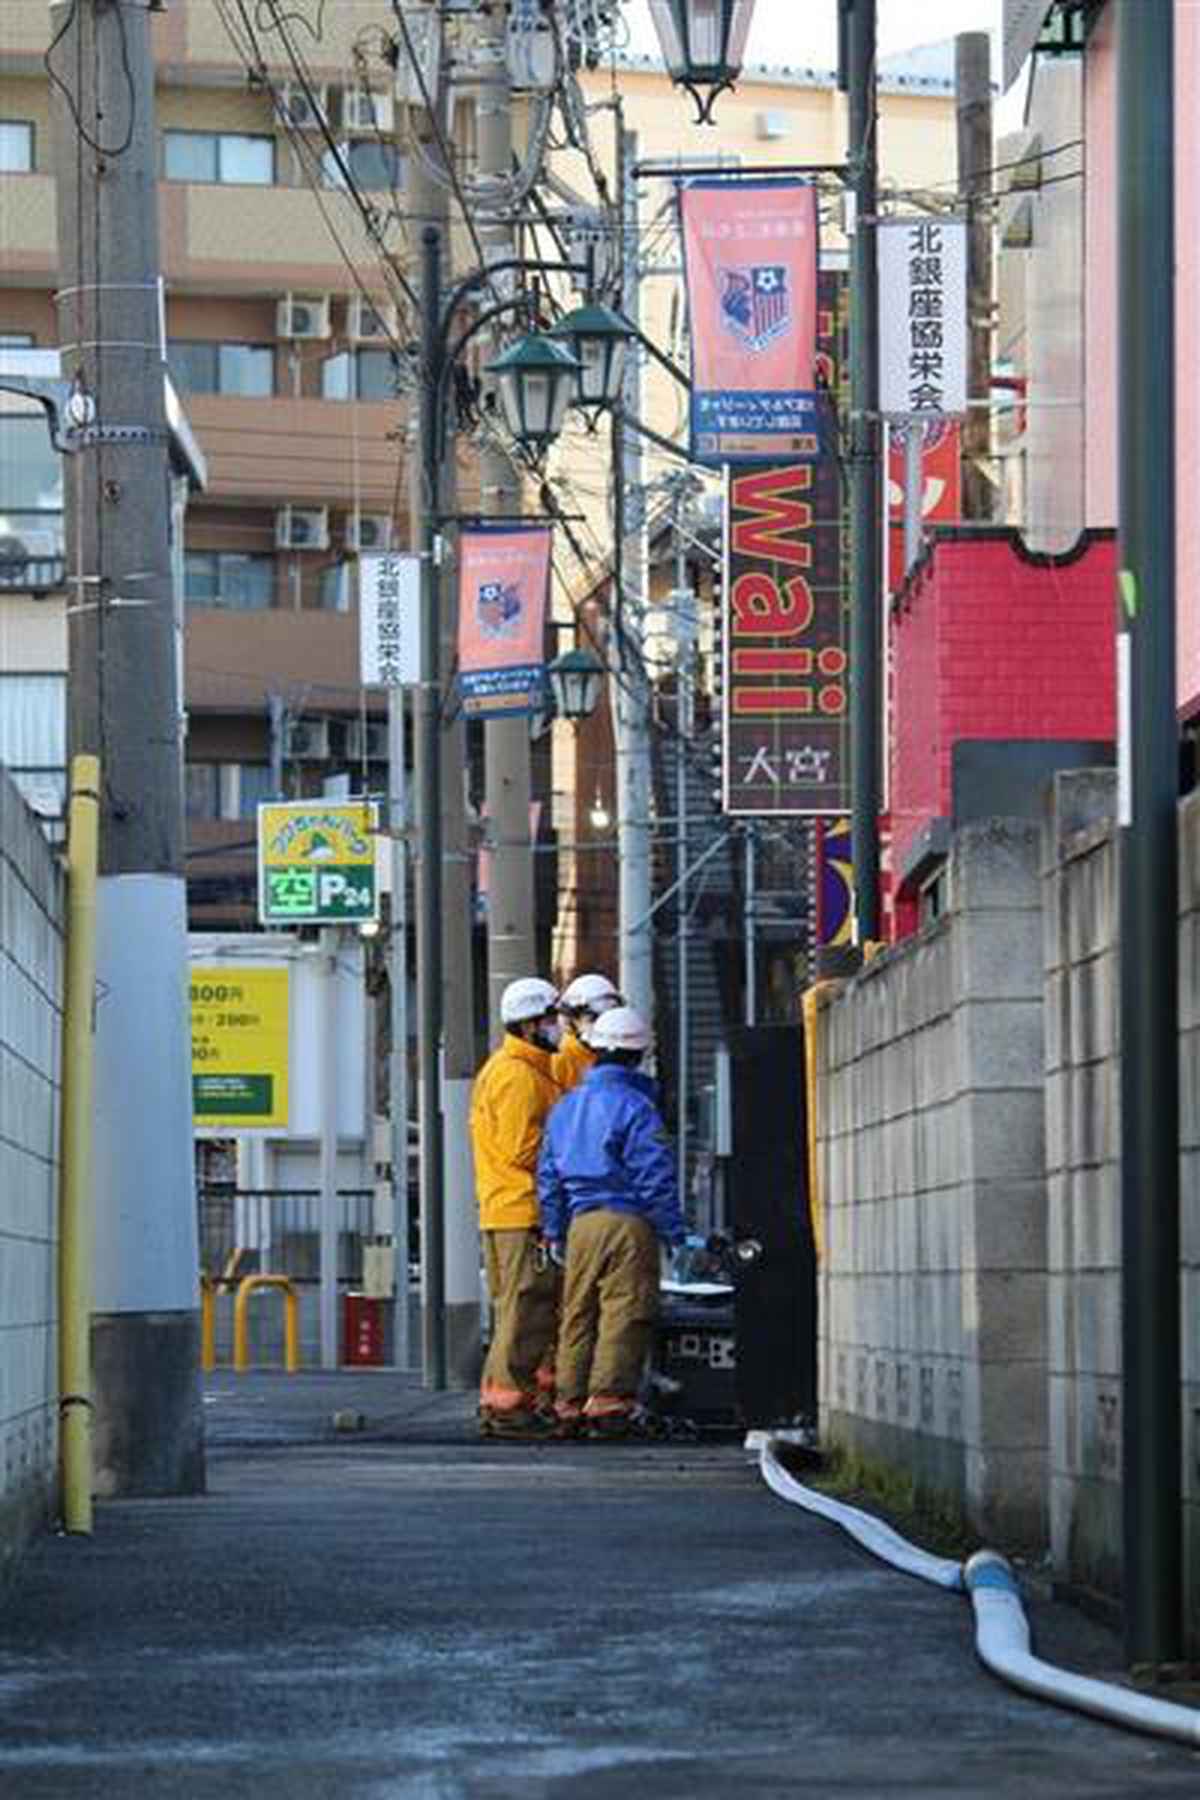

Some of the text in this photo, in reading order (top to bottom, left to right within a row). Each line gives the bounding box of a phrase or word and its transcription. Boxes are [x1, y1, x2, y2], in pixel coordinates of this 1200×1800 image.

[909, 224, 943, 411] 北銀座協栄会
[732, 464, 847, 714] waii
